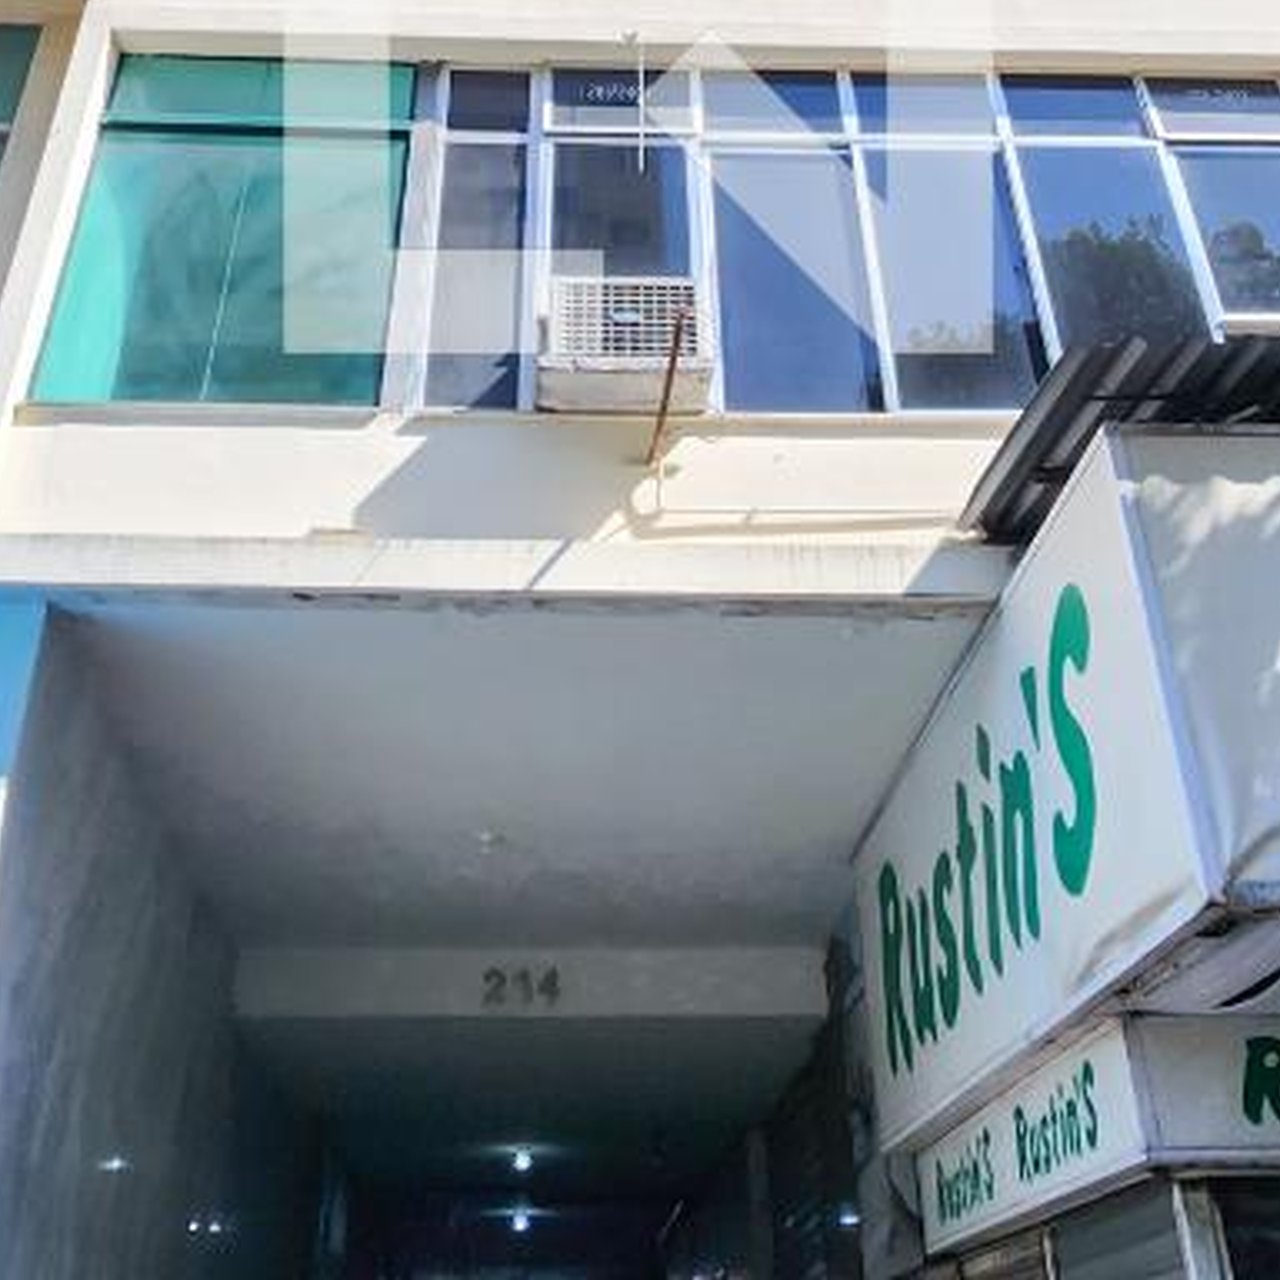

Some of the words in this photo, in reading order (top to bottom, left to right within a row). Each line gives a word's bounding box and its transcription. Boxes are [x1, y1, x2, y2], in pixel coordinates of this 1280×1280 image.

[877, 582, 1097, 1077] Rustin'S
[481, 964, 560, 1007] 214
[1014, 1059, 1098, 1185] Rustin'S
